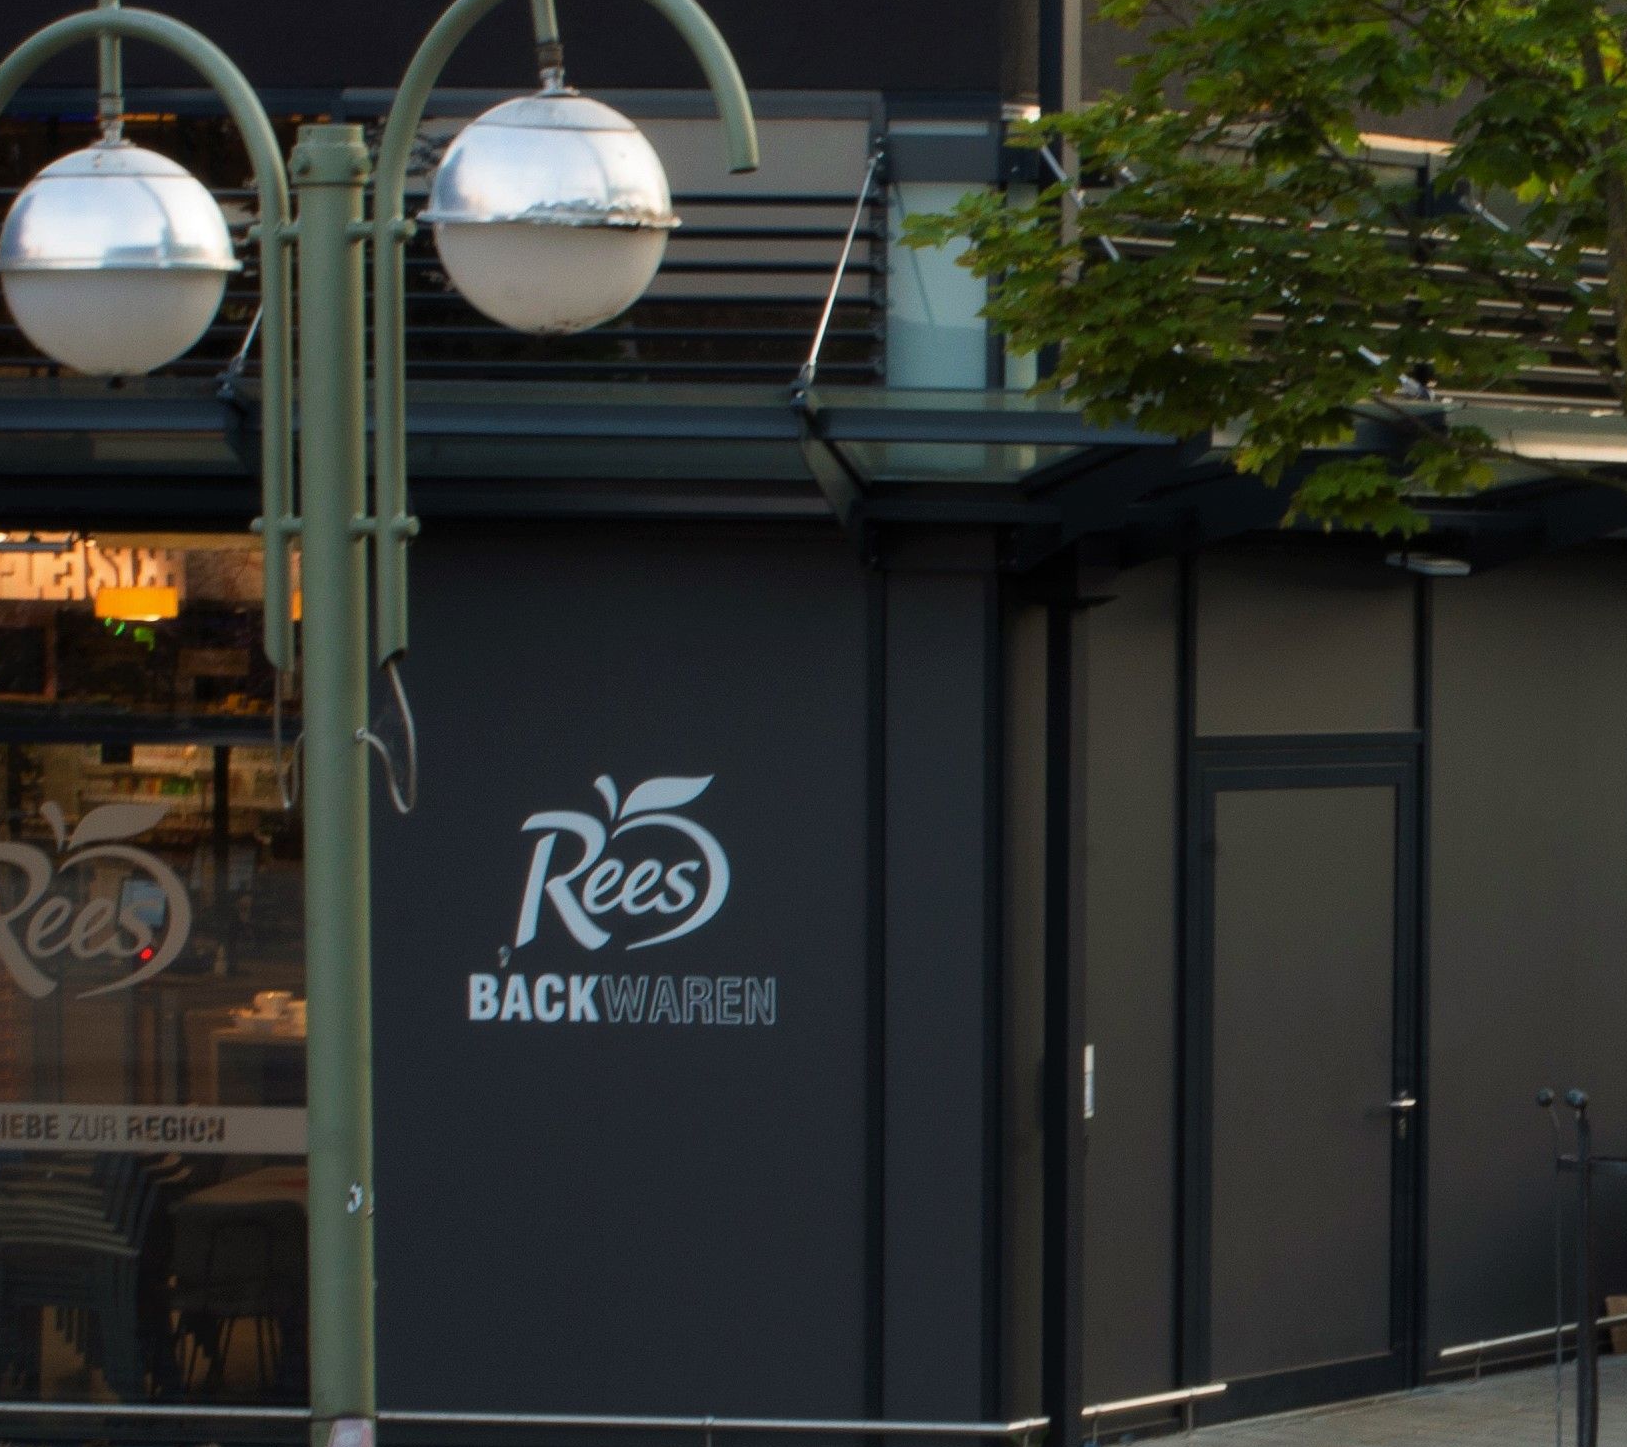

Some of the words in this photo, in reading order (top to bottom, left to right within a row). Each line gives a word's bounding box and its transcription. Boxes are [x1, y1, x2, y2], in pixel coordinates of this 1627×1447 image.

[514, 810, 708, 952] Rees
[467, 972, 777, 1027] BACKWAREN
[67, 1113, 117, 1142] ZUR
[126, 1115, 226, 1144] REGION
